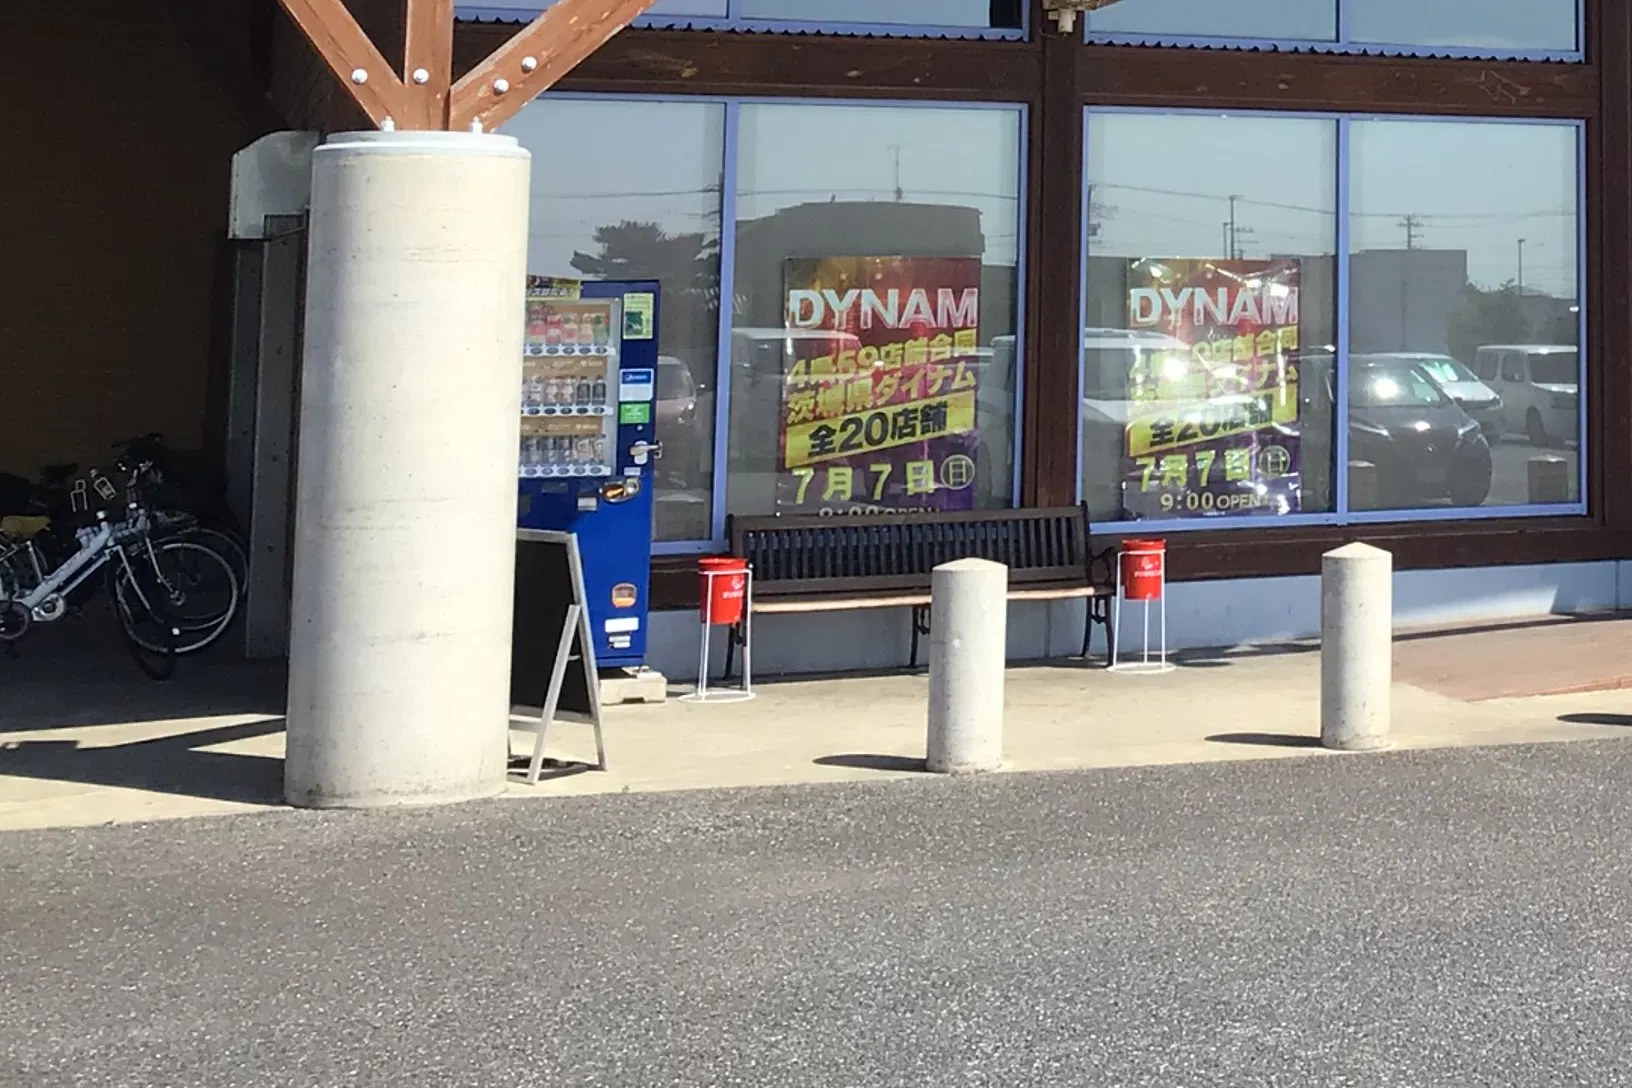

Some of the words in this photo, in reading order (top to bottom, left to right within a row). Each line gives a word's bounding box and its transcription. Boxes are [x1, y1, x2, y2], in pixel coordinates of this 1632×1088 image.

[787, 288, 978, 329] DYNAM
[1130, 287, 1299, 327] DYNAM
[808, 400, 948, 458] 全20店舗
[1160, 492, 1214, 512] 9:00
